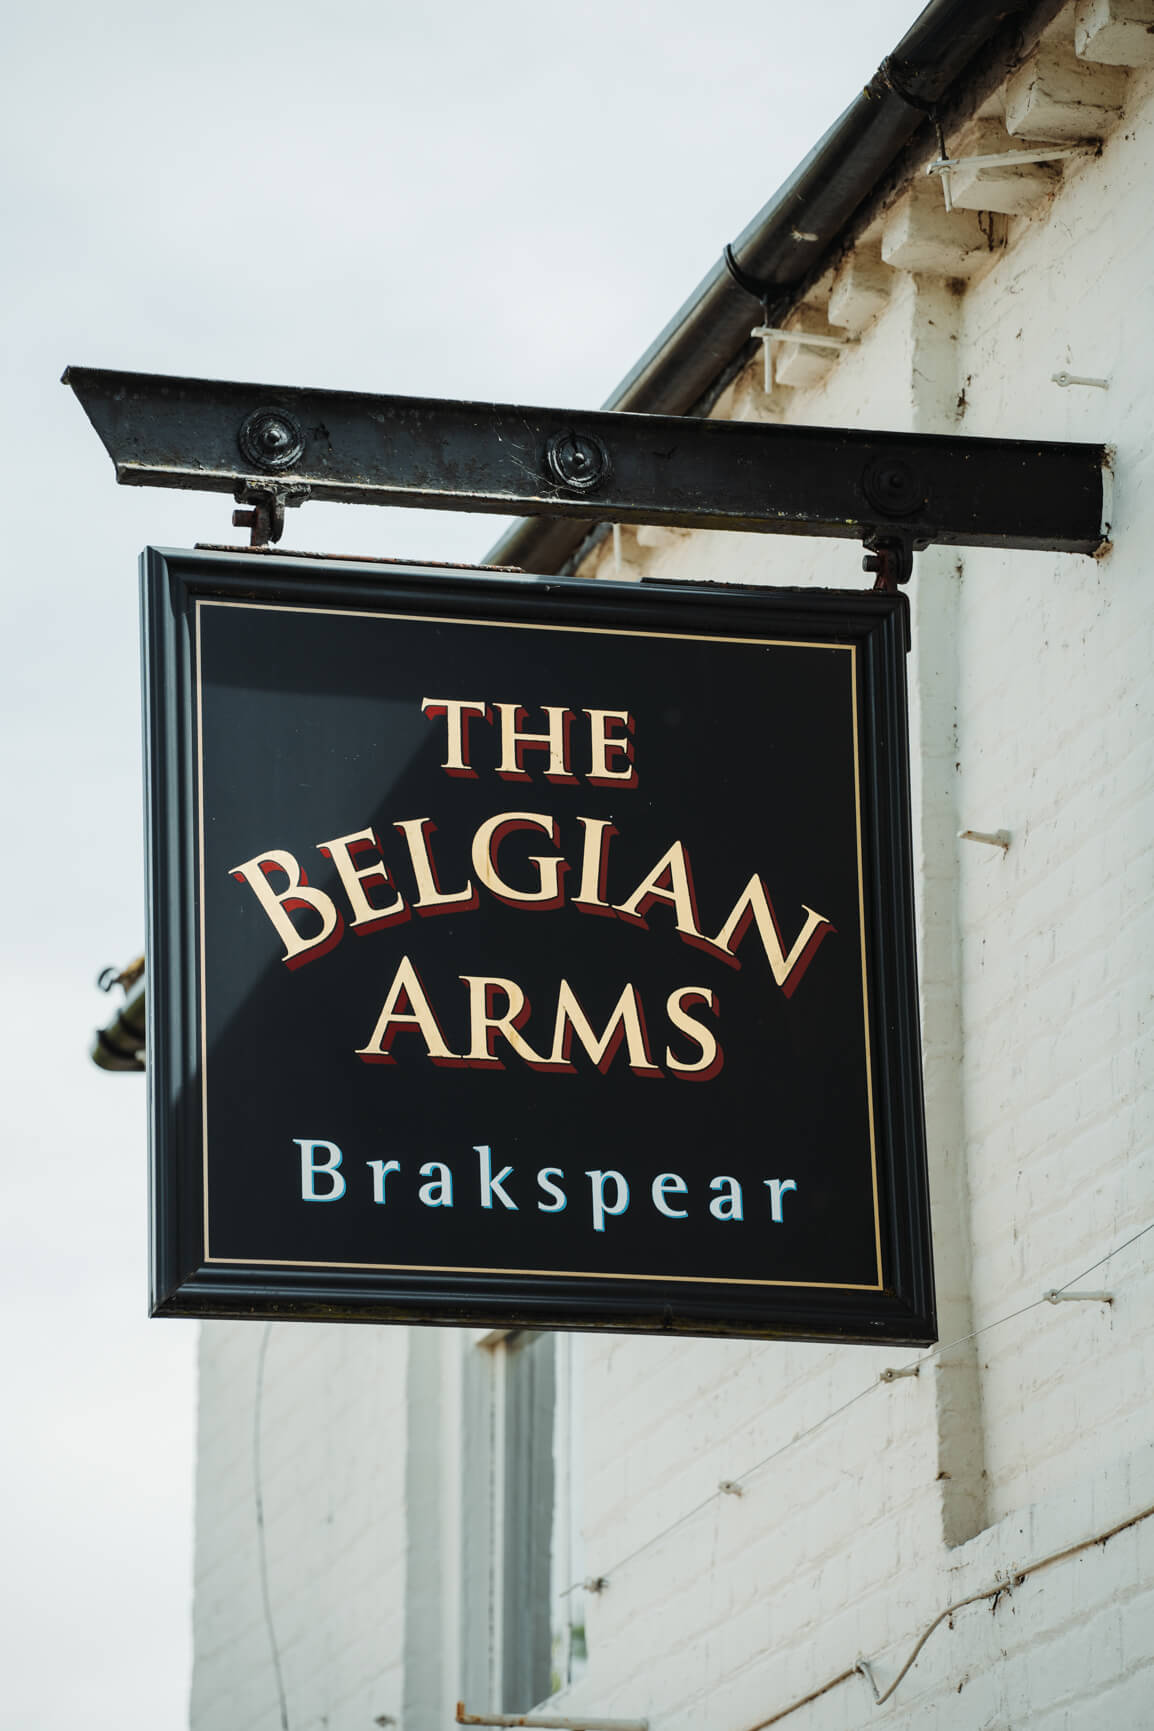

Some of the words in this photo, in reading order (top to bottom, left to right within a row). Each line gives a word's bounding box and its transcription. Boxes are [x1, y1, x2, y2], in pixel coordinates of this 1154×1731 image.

[421, 697, 637, 788] THE
[228, 812, 833, 994] BELGIAN
[355, 956, 722, 1078] ARMS
[293, 1139, 798, 1232] Brakspear
